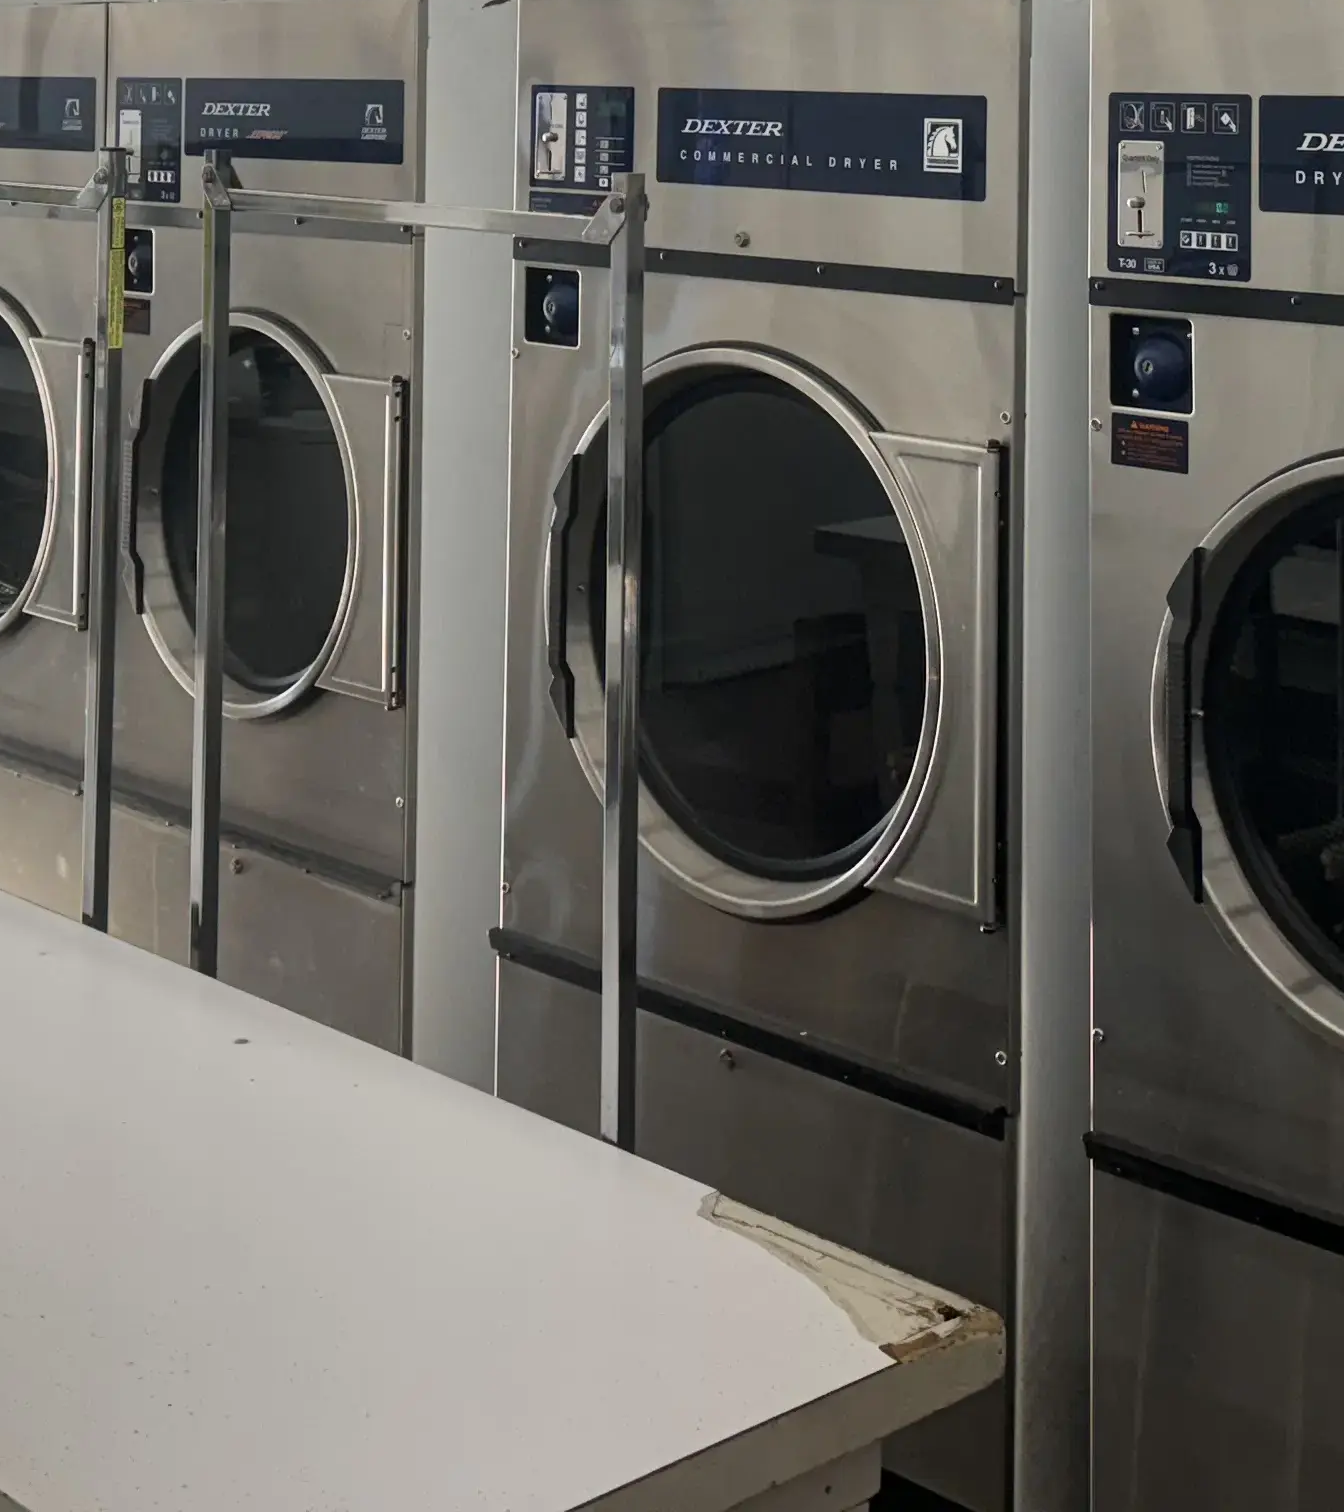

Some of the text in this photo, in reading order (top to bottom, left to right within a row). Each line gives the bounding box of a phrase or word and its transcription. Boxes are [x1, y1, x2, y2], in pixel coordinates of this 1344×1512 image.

[201, 102, 272, 117] DEXTER
[200, 128, 240, 139] DRYER
[681, 118, 783, 137] DEXTER
[680, 149, 898, 171] COMMERCIAL DRYER
[1118, 258, 1136, 269] T-30
[1208, 262, 1225, 276] 3 x
